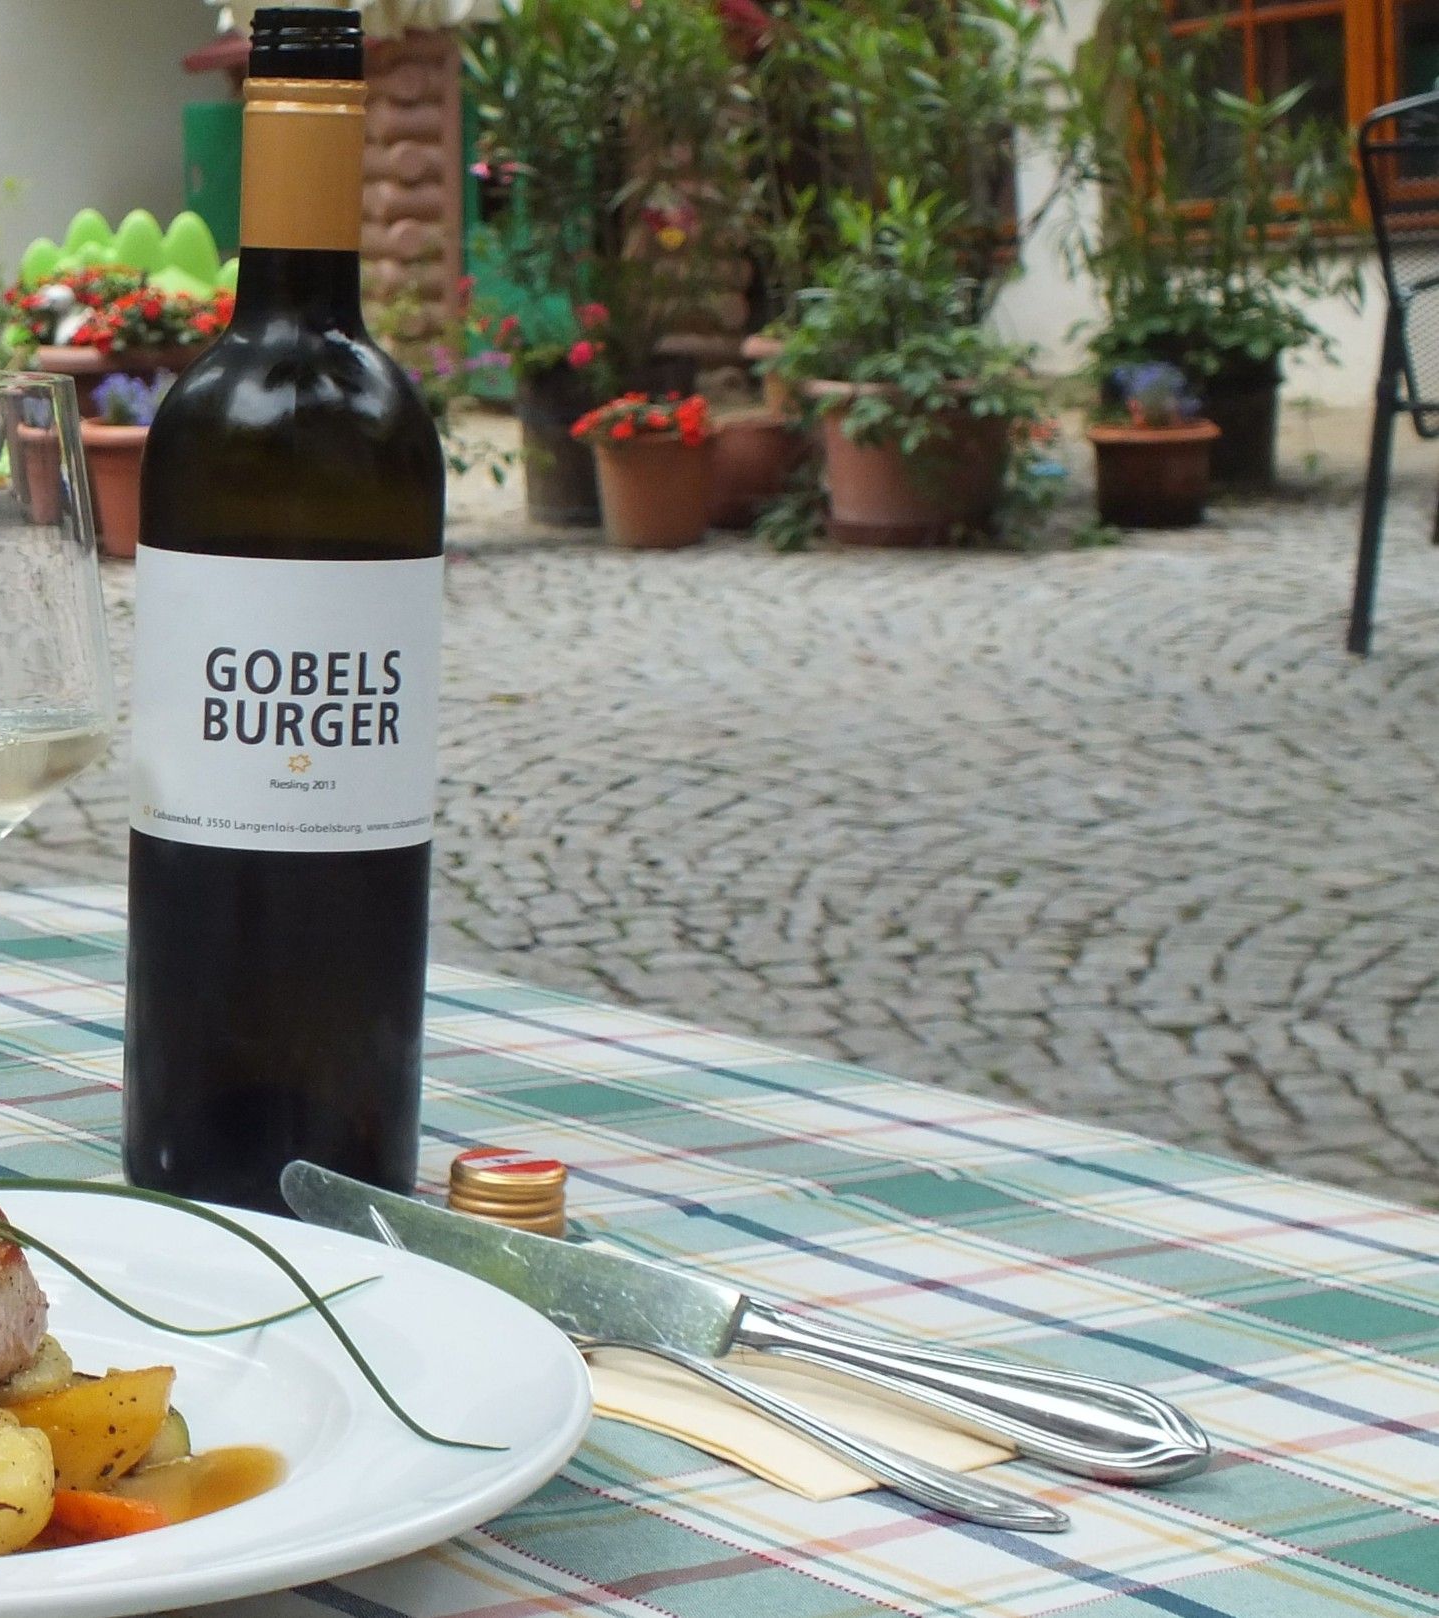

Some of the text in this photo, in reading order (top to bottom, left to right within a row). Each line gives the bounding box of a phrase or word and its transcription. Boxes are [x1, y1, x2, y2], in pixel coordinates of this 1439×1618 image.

[206, 647, 402, 696] GOBELS
[203, 697, 400, 747] BURGER
[270, 779, 337, 792] Riesling 2013
[206, 817, 232, 829] 3550
[234, 820, 364, 835] Langenlois-Gobelsburg,
